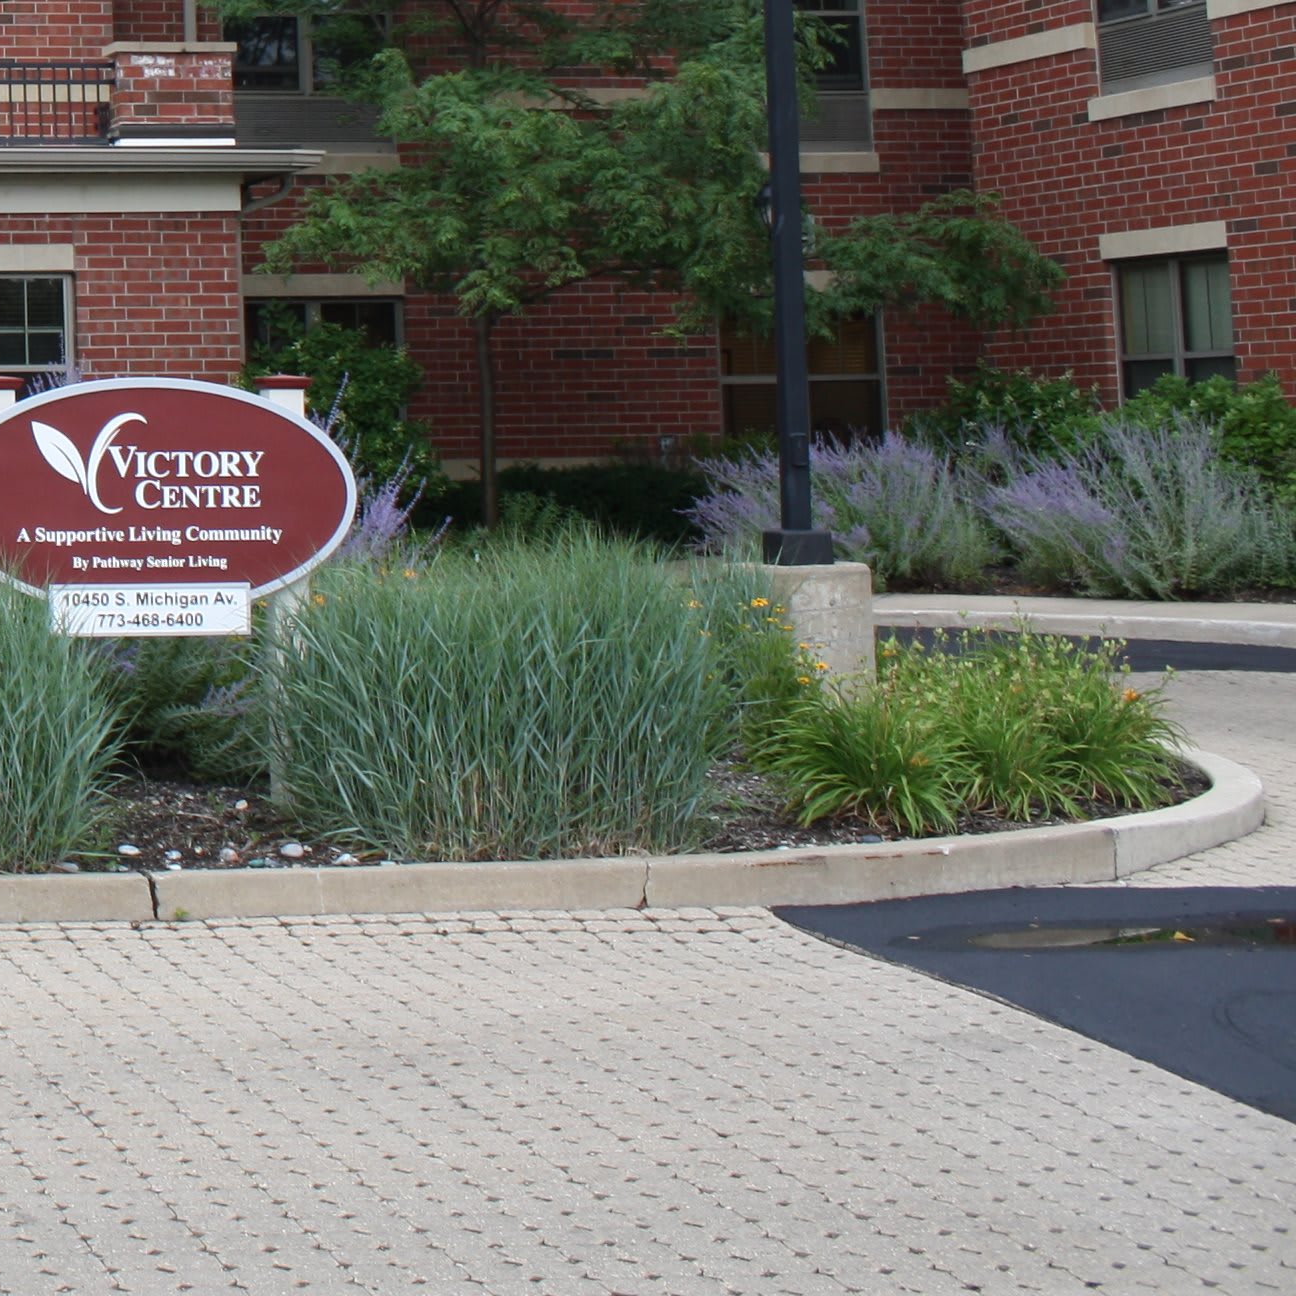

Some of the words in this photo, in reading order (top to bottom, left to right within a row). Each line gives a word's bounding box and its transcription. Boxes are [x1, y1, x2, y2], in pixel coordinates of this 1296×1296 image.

[108, 446, 264, 479] VICTORY
[135, 479, 262, 510] CENTRE
[16, 527, 31, 543] A
[35, 527, 125, 546] Supportive
[128, 526, 182, 545] Living
[185, 526, 283, 544] Community
[72, 556, 90, 572] By
[92, 556, 144, 571] Pathway
[146, 556, 185, 568] Senior
[188, 555, 228, 570] Living
[64, 592, 109, 607] 10450
[114, 592, 130, 607] S.
[136, 591, 209, 609] Michigan
[213, 591, 238, 606] Av.
[98, 612, 204, 628] 773-468-6400
